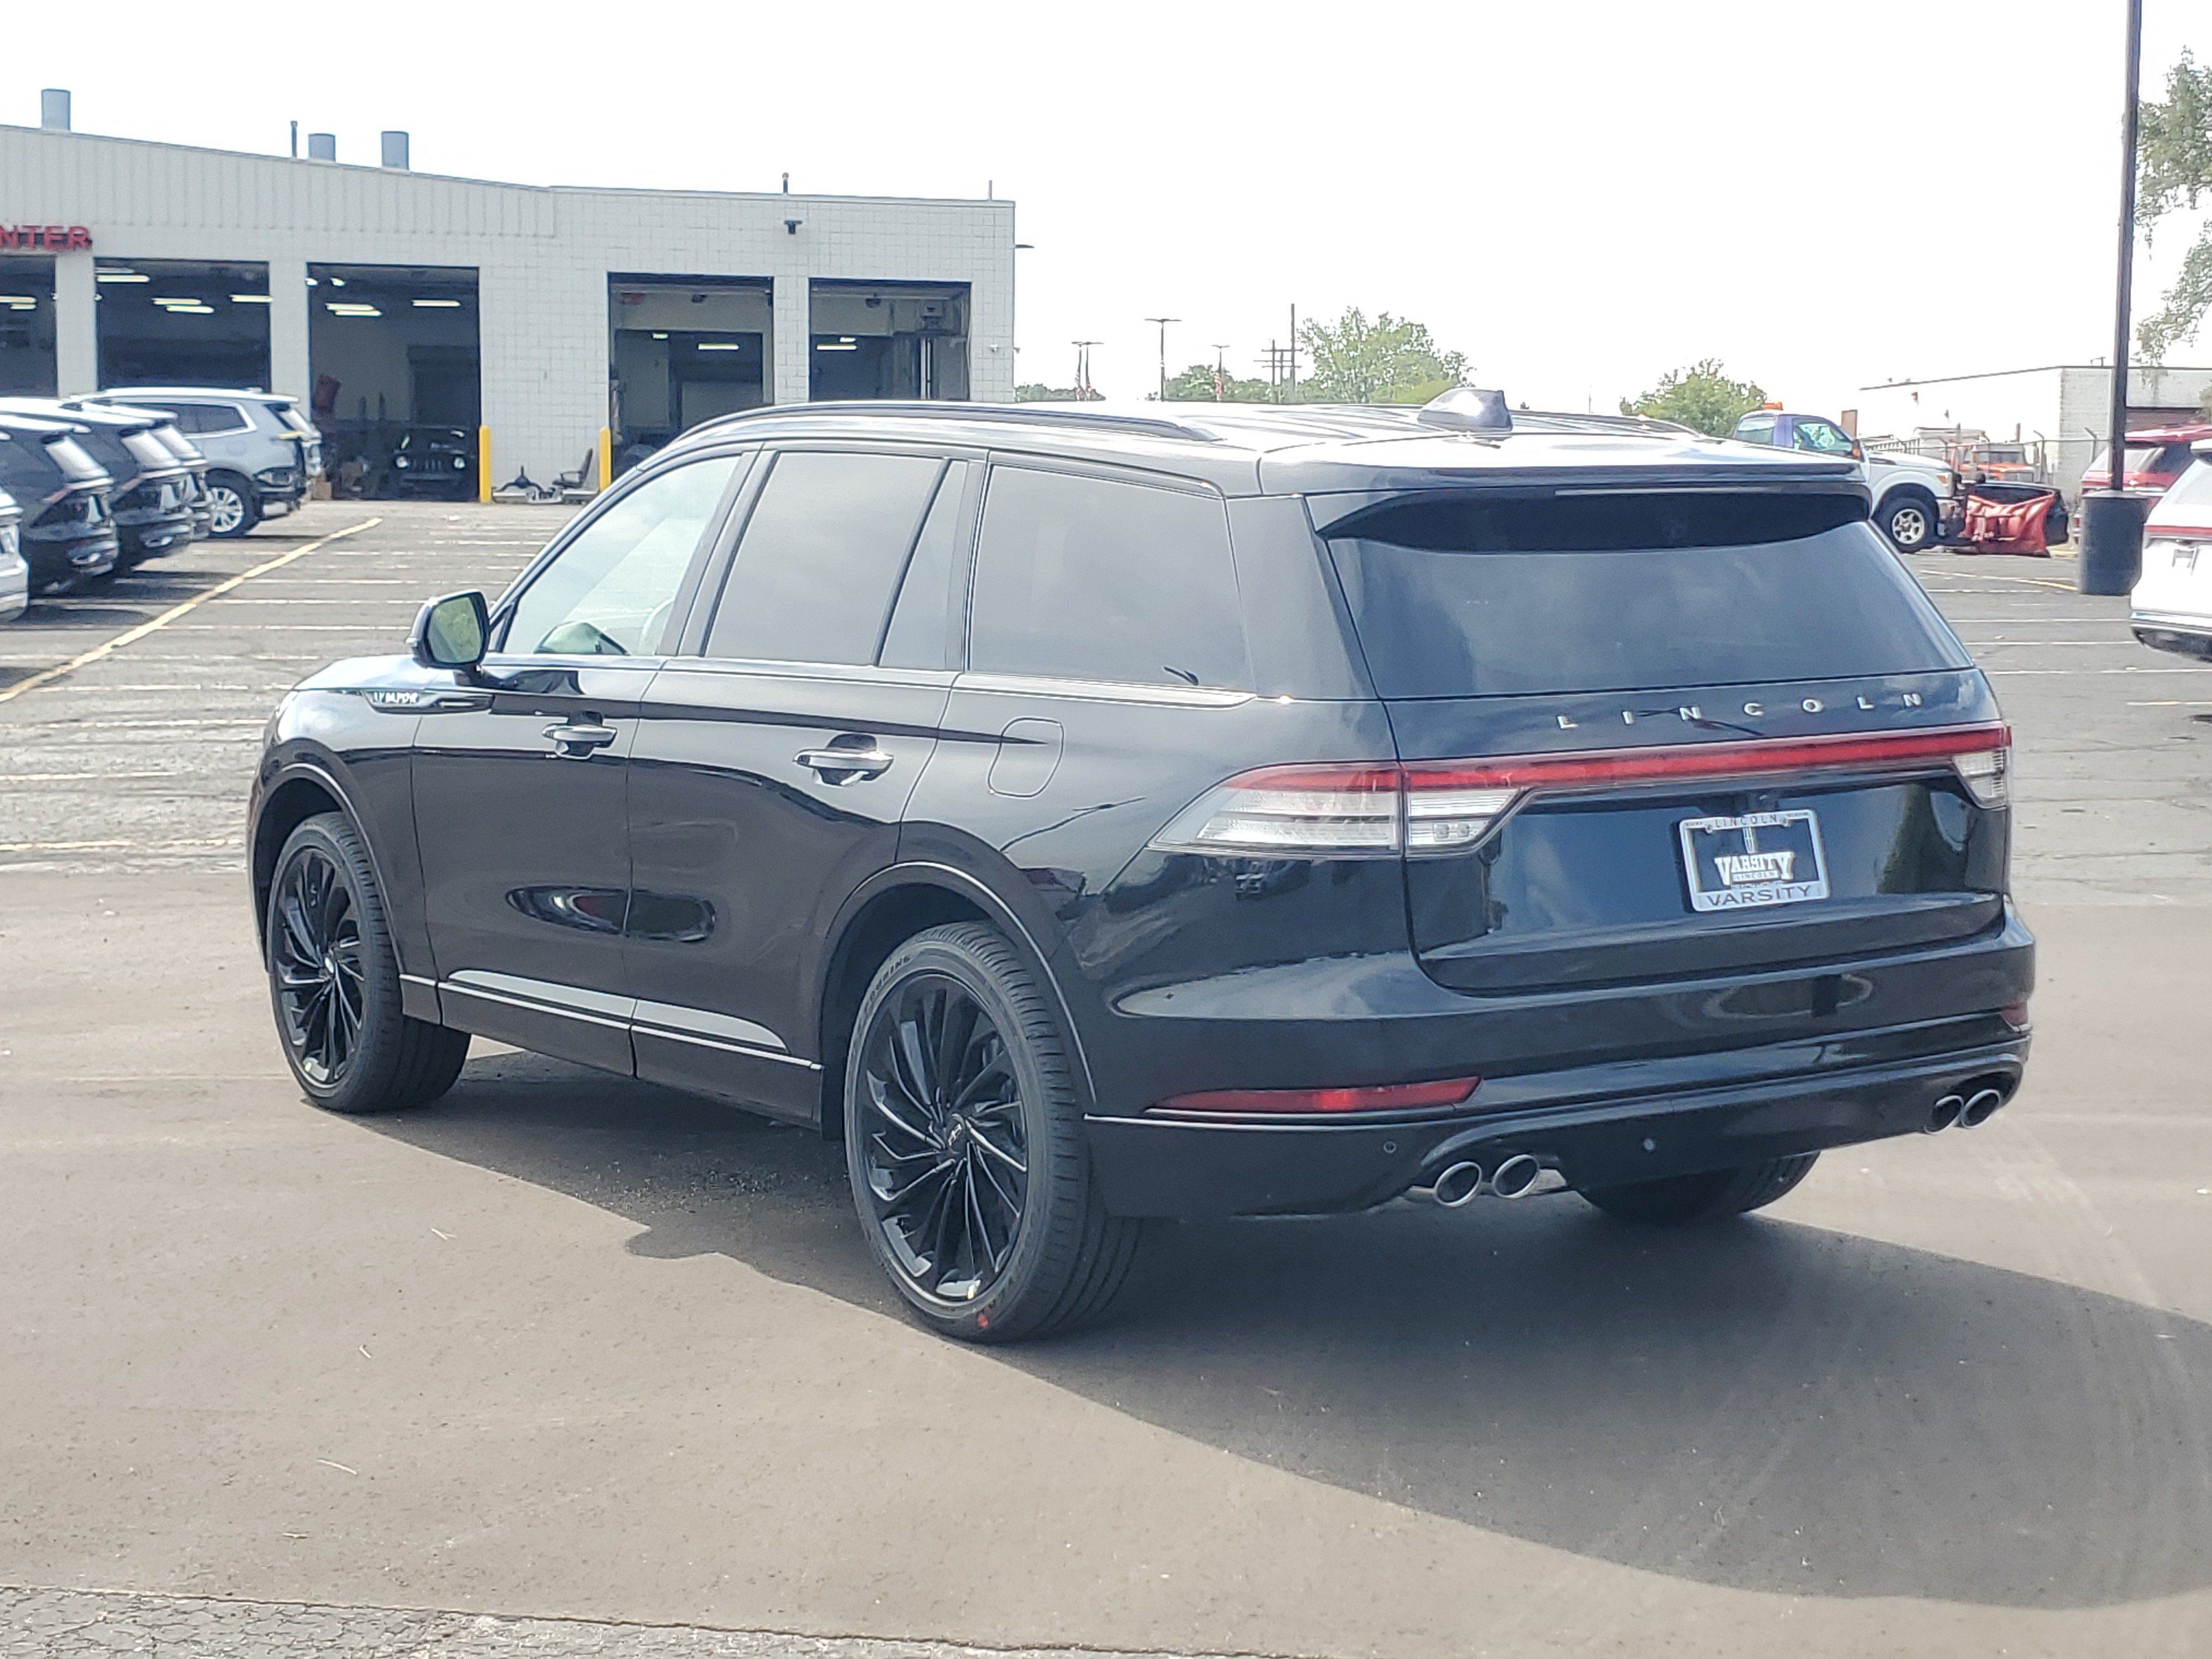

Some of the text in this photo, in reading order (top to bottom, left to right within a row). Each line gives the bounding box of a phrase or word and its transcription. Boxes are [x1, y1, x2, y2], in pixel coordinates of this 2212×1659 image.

[1557, 693, 1922, 730] LINCOLN
[1715, 814, 1778, 828] LINCOLN
[1714, 851, 1794, 886] VARSITY
[1707, 885, 1810, 906] VARSITY
